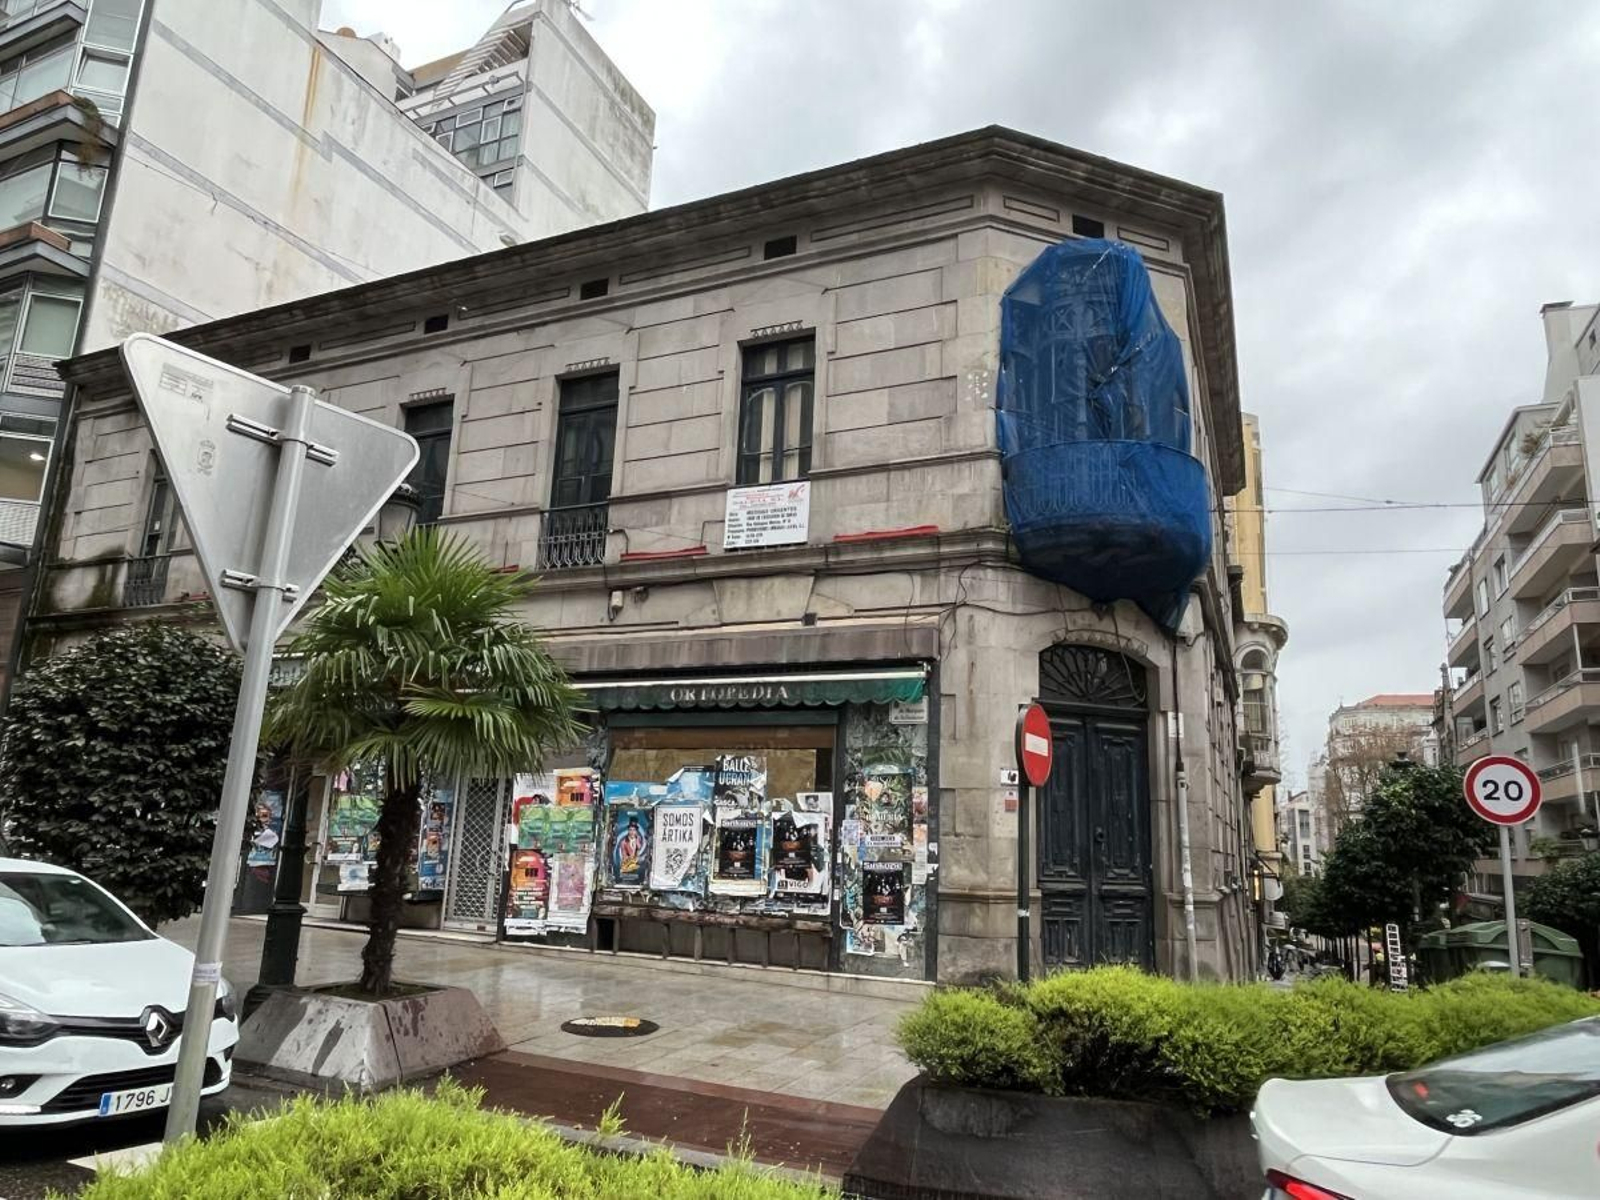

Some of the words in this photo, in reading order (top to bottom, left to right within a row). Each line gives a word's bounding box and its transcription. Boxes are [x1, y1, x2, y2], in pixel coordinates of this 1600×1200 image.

[1481, 779, 1524, 801] 20
[663, 812, 694, 827] SOMOS
[788, 880, 808, 888] VIGO
[115, 1090, 155, 1112] 1796
